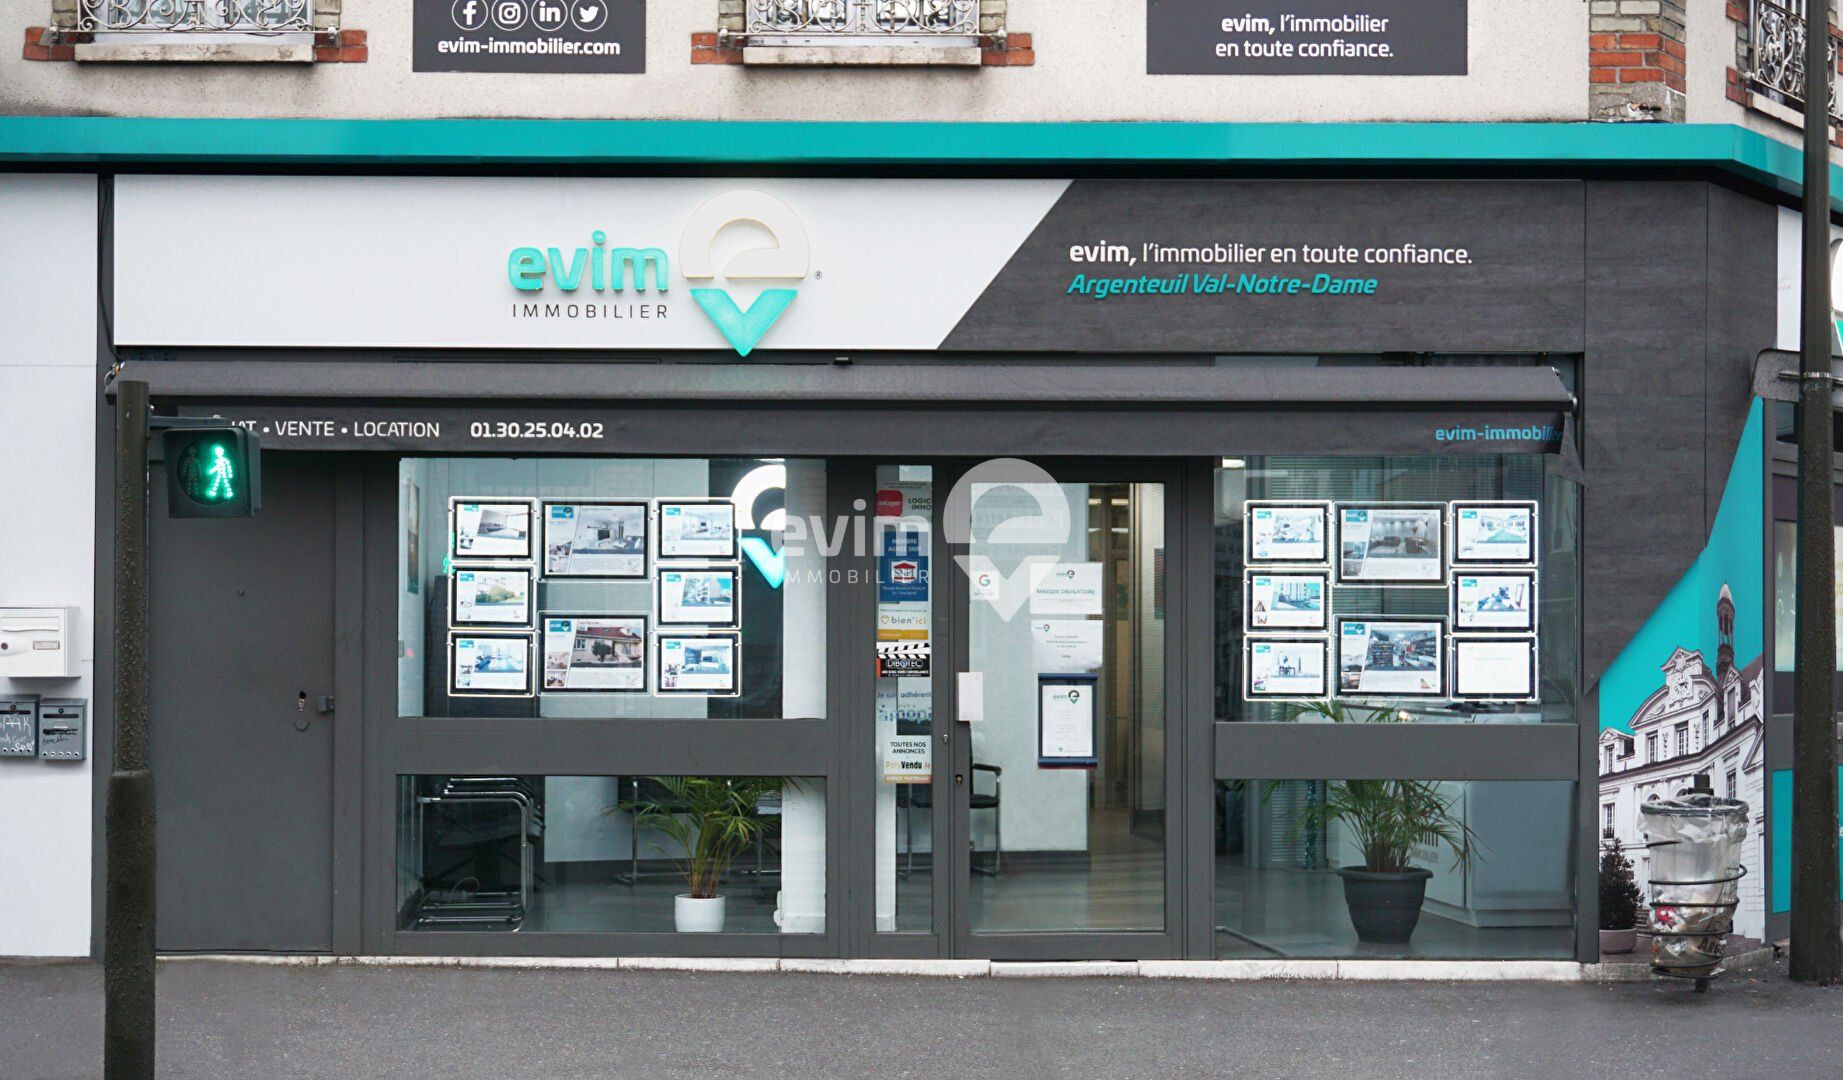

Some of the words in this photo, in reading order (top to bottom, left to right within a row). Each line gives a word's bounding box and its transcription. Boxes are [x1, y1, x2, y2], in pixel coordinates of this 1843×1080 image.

[1221, 14, 1276, 36] evim,
[437, 36, 621, 55] evim-immobilier.com
[1215, 42, 1239, 57] en
[1243, 40, 1294, 57] toute
[1298, 39, 1394, 58] confiance.
[507, 230, 669, 292] evim
[1069, 240, 1137, 267] evim,
[1270, 248, 1297, 263] en
[1302, 245, 1359, 263] toute
[1364, 244, 1473, 264] confiance.
[1067, 273, 1190, 299] Argenteuil
[1193, 274, 1378, 296] Val-Notre-Dame
[512, 303, 667, 319] IMMOBILIER
[274, 420, 335, 437] VENTE
[354, 421, 440, 438] LOCATION
[470, 421, 604, 440] 01.30.25.04.02
